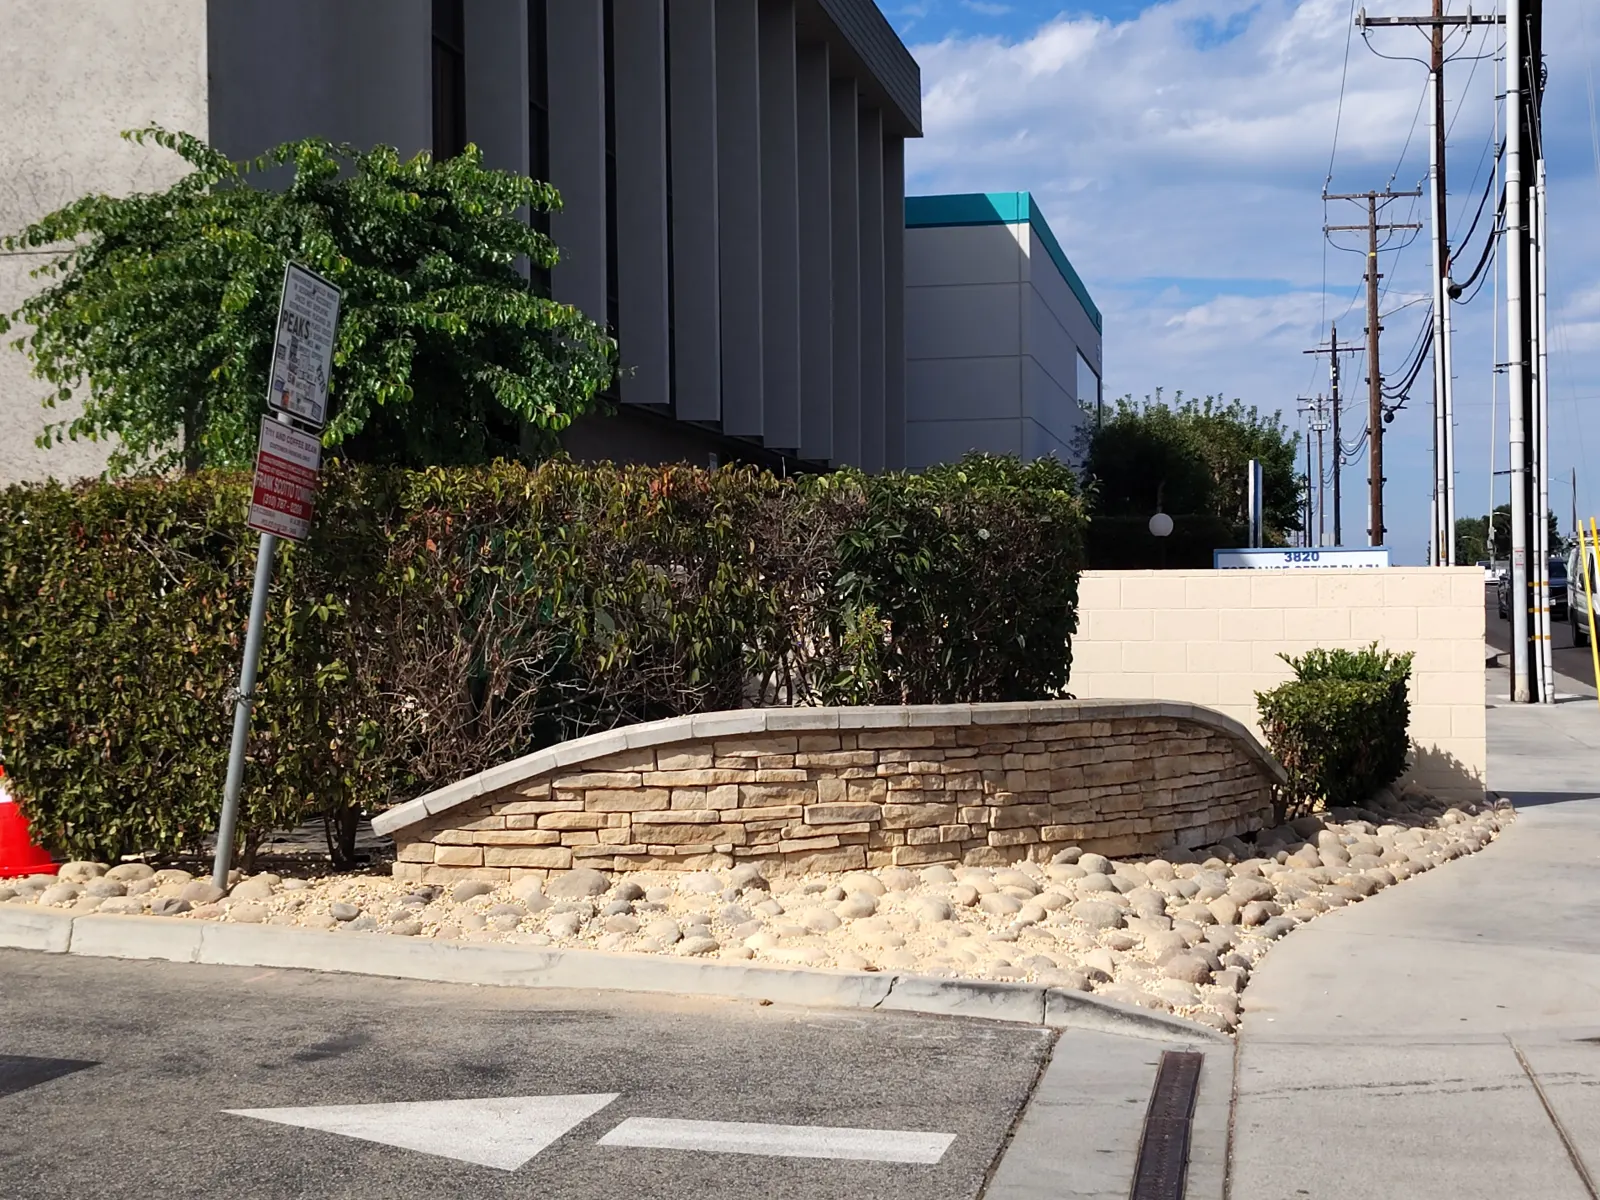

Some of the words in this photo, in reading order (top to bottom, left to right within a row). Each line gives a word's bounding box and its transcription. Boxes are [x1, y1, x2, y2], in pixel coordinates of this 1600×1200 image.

[281, 310, 310, 339] PEAKS
[276, 432, 287, 442] AND
[287, 435, 305, 449] COFFEE
[305, 442, 318, 455] BEAN
[256, 470, 275, 492] FRANK
[274, 477, 295, 499] SCOTTO
[1284, 552, 1320, 563] 3820
